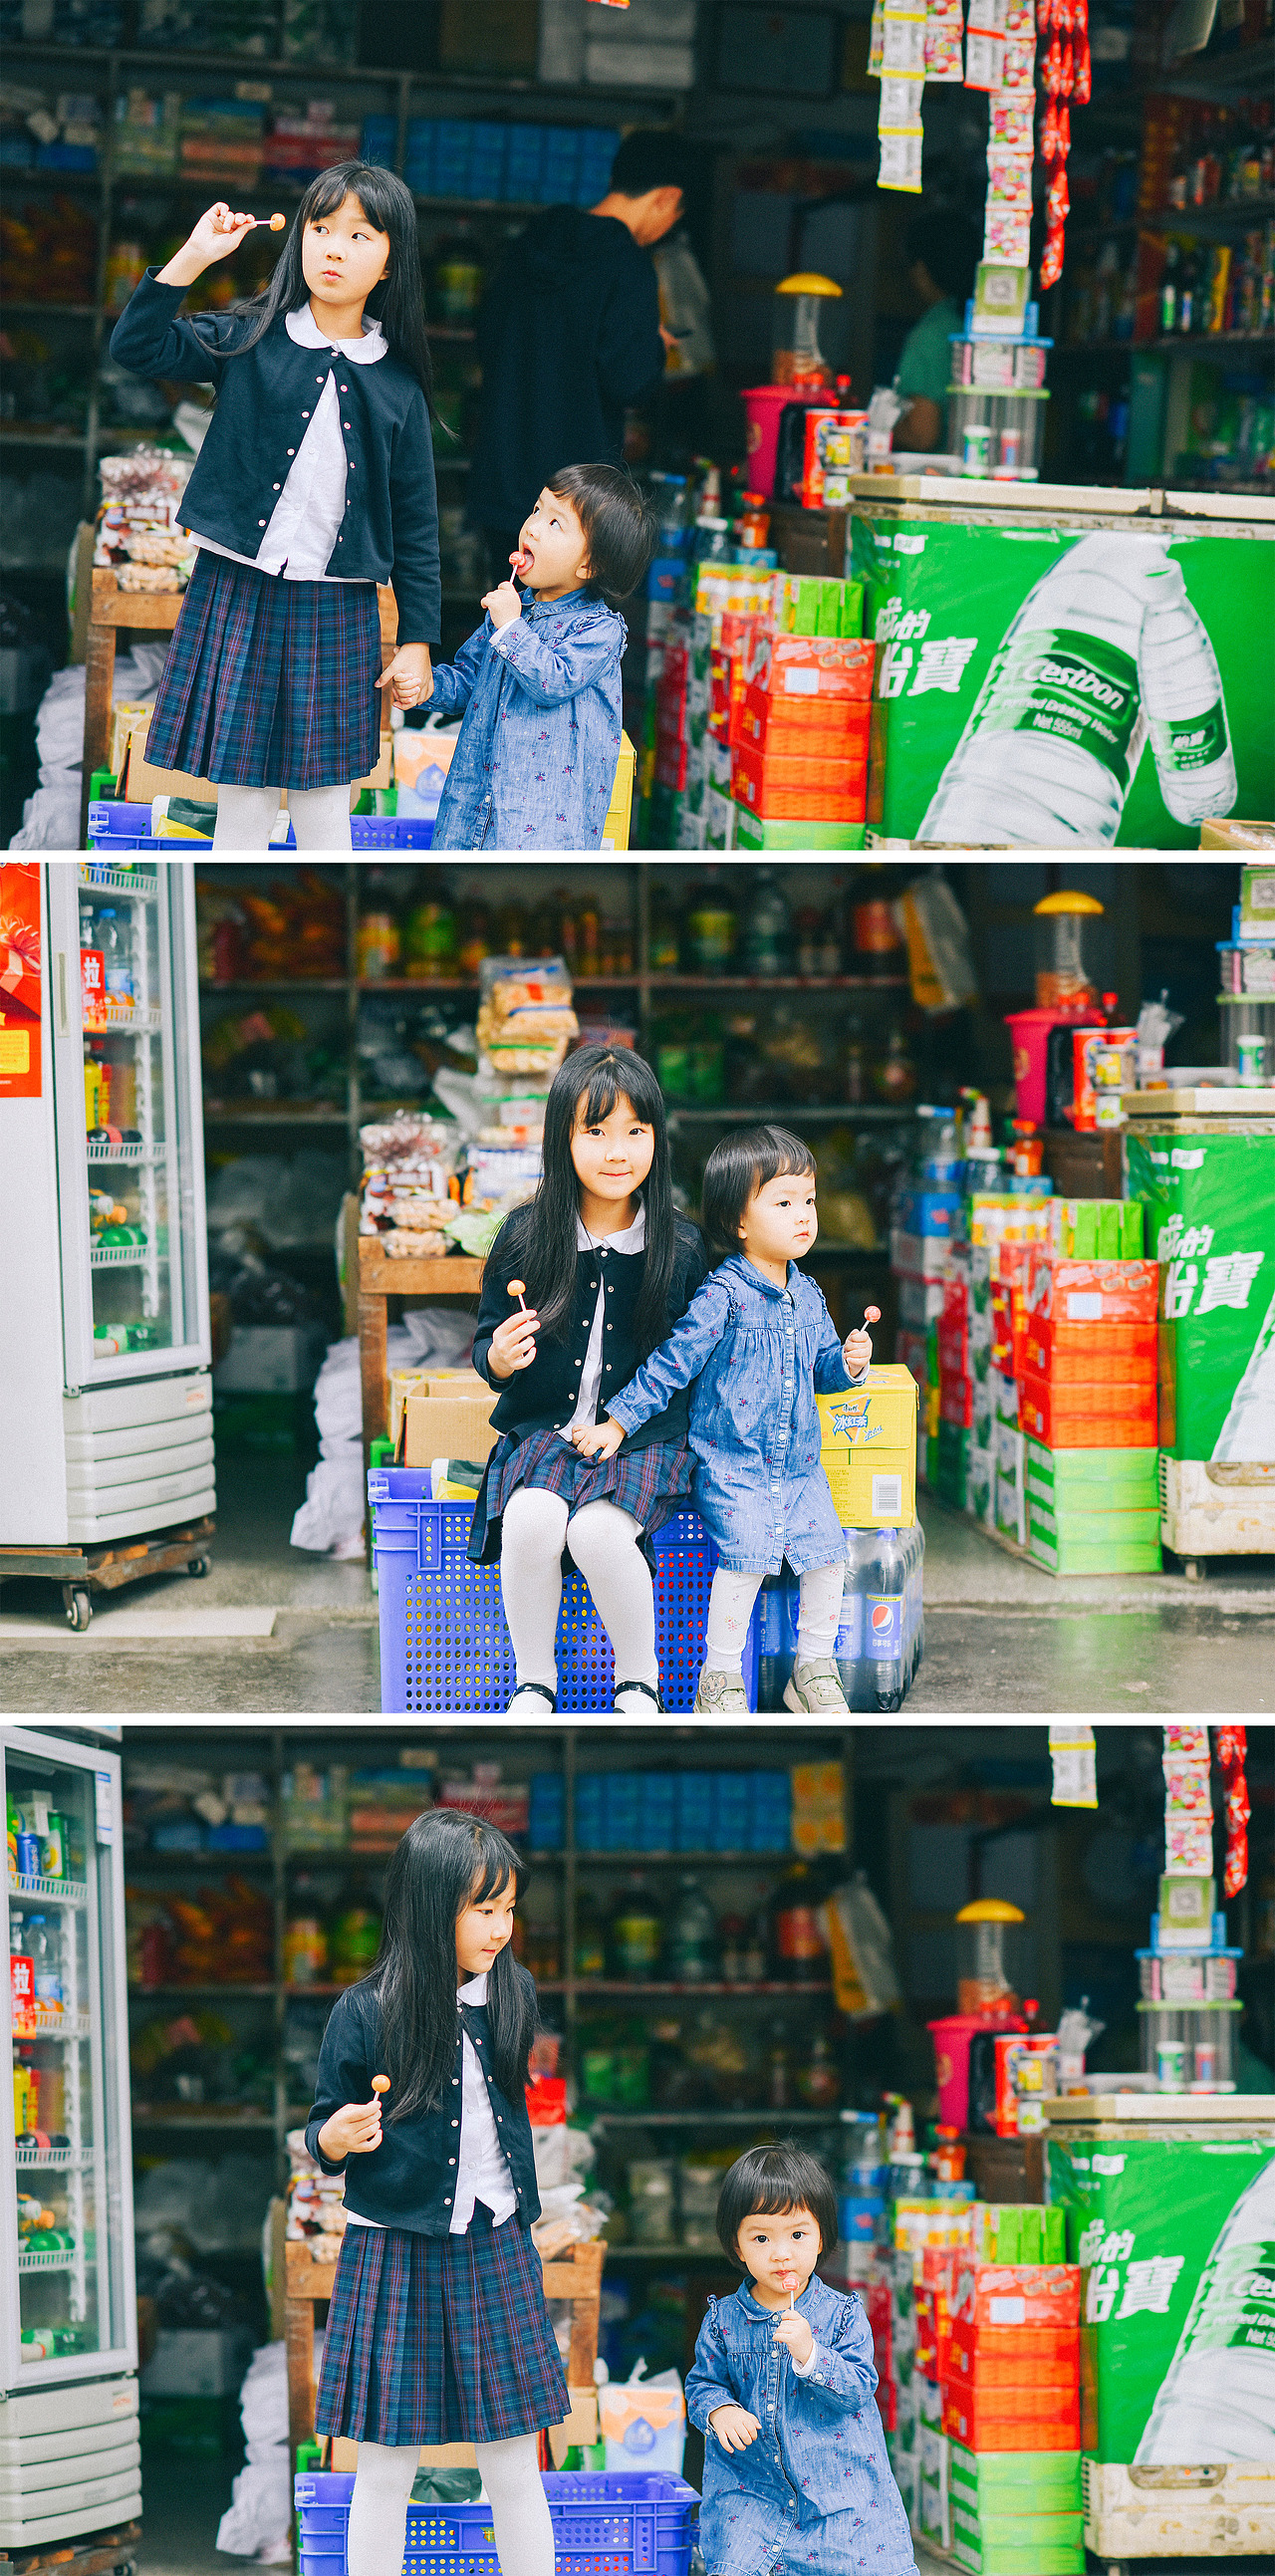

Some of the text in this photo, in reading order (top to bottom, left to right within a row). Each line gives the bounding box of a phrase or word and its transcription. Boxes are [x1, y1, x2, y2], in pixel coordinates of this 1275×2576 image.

[1022, 657, 1125, 710] Cestbon
[84, 956, 101, 989] 拉
[13, 1962, 31, 1995] 拉
